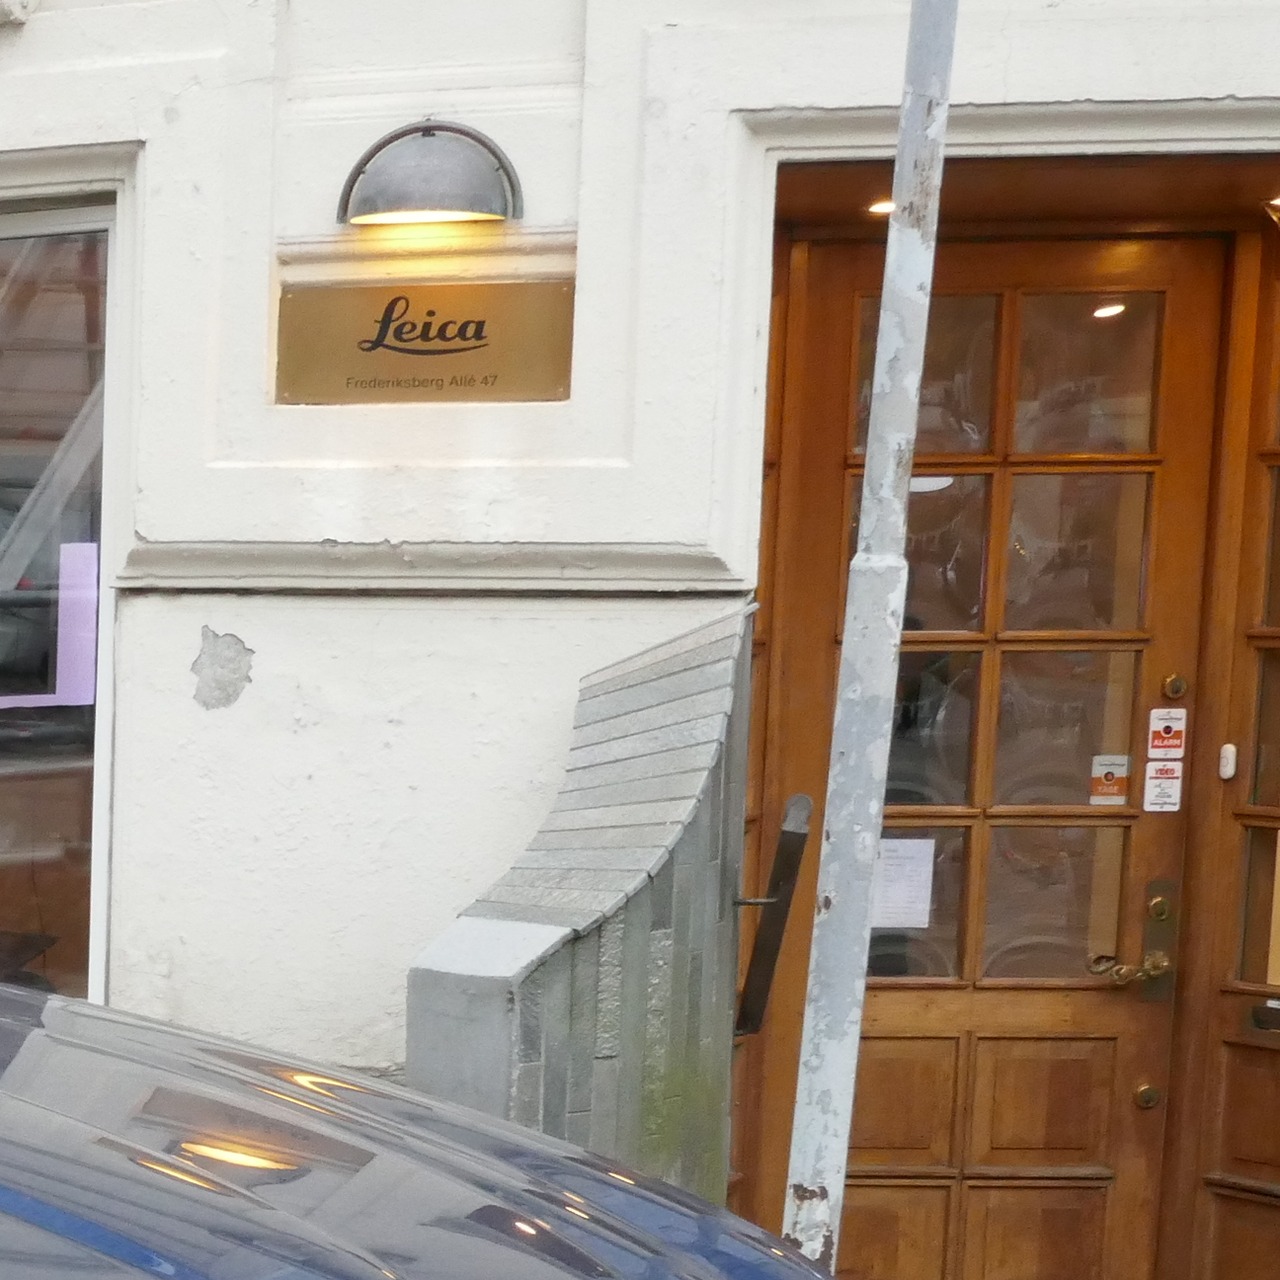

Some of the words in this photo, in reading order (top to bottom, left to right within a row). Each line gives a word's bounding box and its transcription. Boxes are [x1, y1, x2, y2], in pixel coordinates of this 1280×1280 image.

[357, 296, 489, 356] Leica
[345, 376, 444, 391] Frederiksberg
[449, 374, 476, 387] Allé
[480, 374, 498, 387] 47
[1155, 768, 1175, 776] VIDEO
